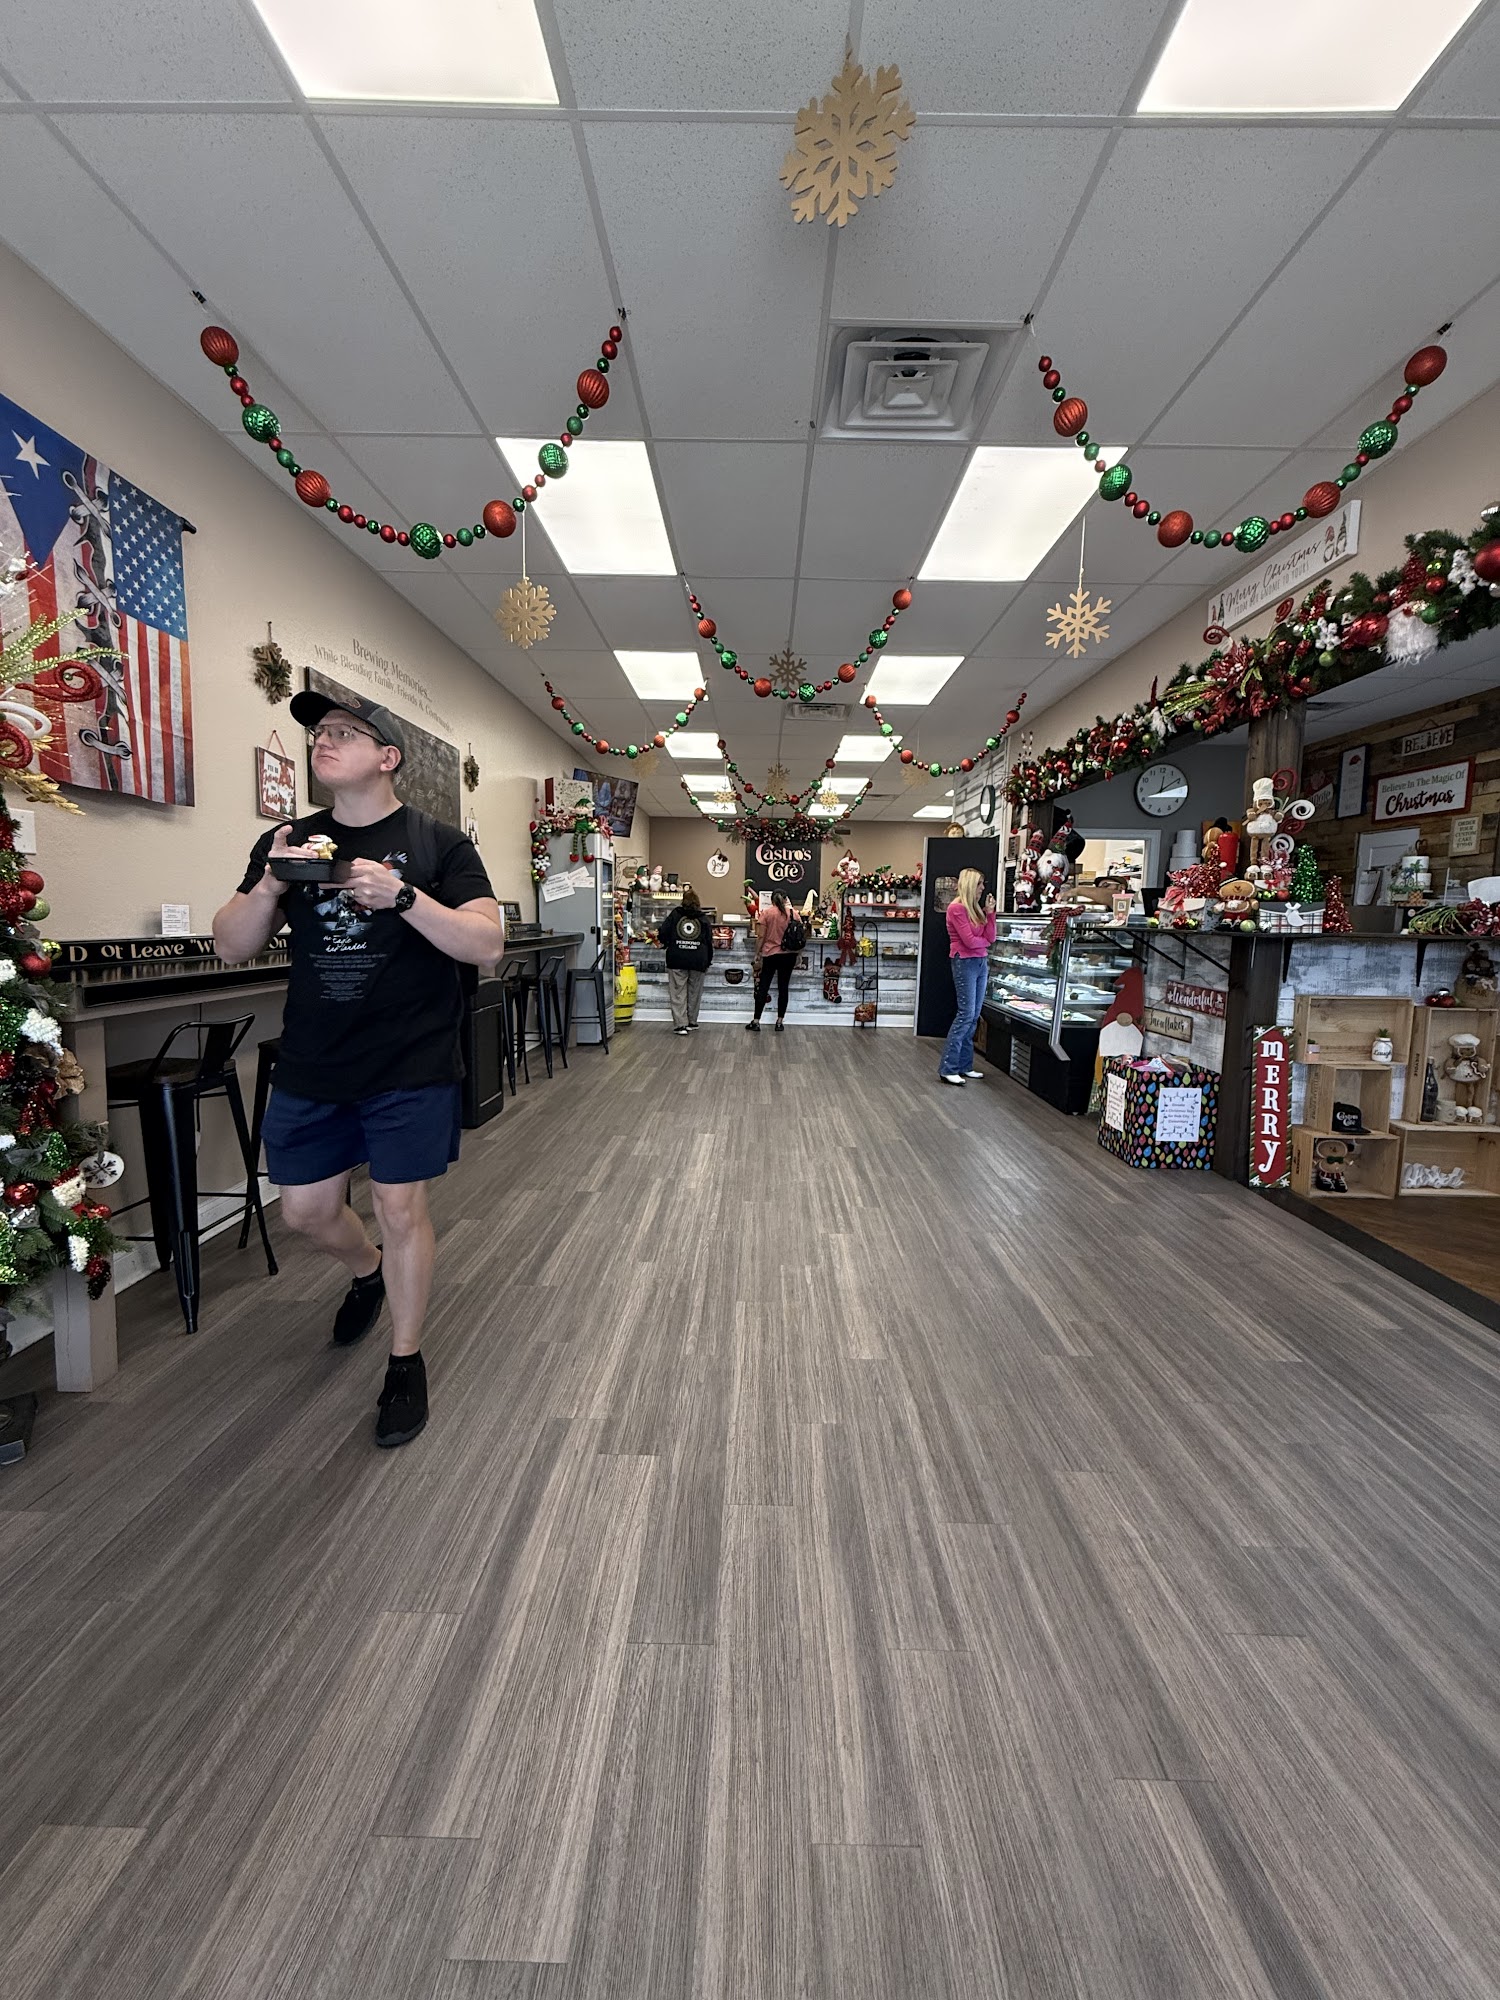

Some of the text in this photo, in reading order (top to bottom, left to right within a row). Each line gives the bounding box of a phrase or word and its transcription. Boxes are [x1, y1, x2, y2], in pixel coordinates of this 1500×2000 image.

[1225, 541, 1321, 612] Merry Christmas
[314, 644, 339, 665] While
[340, 654, 374, 683] Blending
[352, 638, 389, 676] Brewing
[1382, 769, 1466, 793] Believe In The Magic Of
[1385, 789, 1455, 816] Christmas
[1455, 830, 1477, 838] CUSTOM
[1457, 819, 1476, 827] ORDER
[711, 859, 725, 872] Joy
[755, 843, 812, 866] Castro's
[130, 943, 185, 959] Leave
[340, 941, 367, 952] landed
